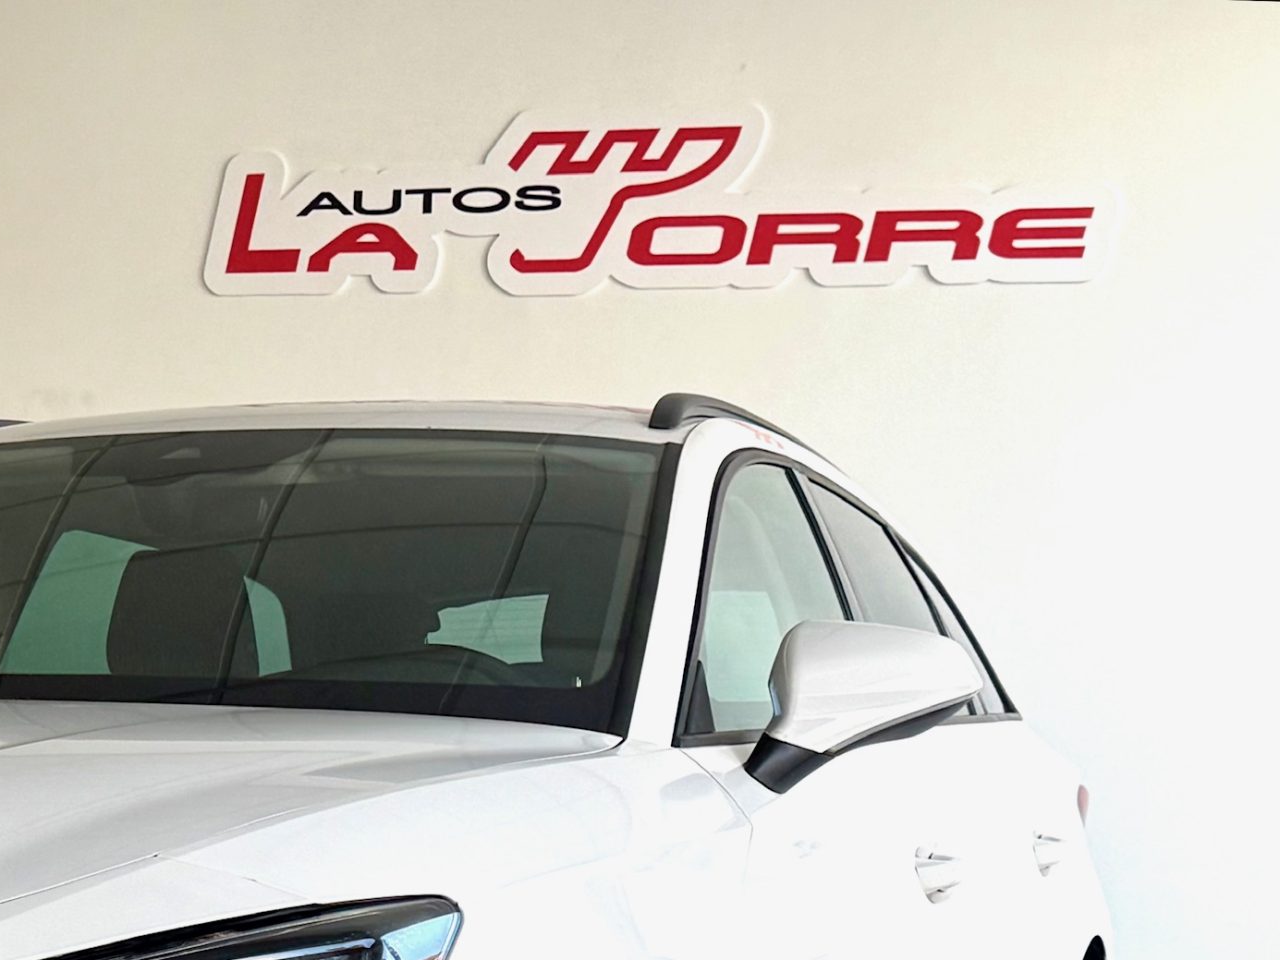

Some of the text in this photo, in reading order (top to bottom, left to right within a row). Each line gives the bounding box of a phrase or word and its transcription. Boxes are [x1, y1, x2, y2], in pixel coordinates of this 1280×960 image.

[225, 125, 1094, 274] LA TORRE
[296, 185, 563, 217] AUTOS
